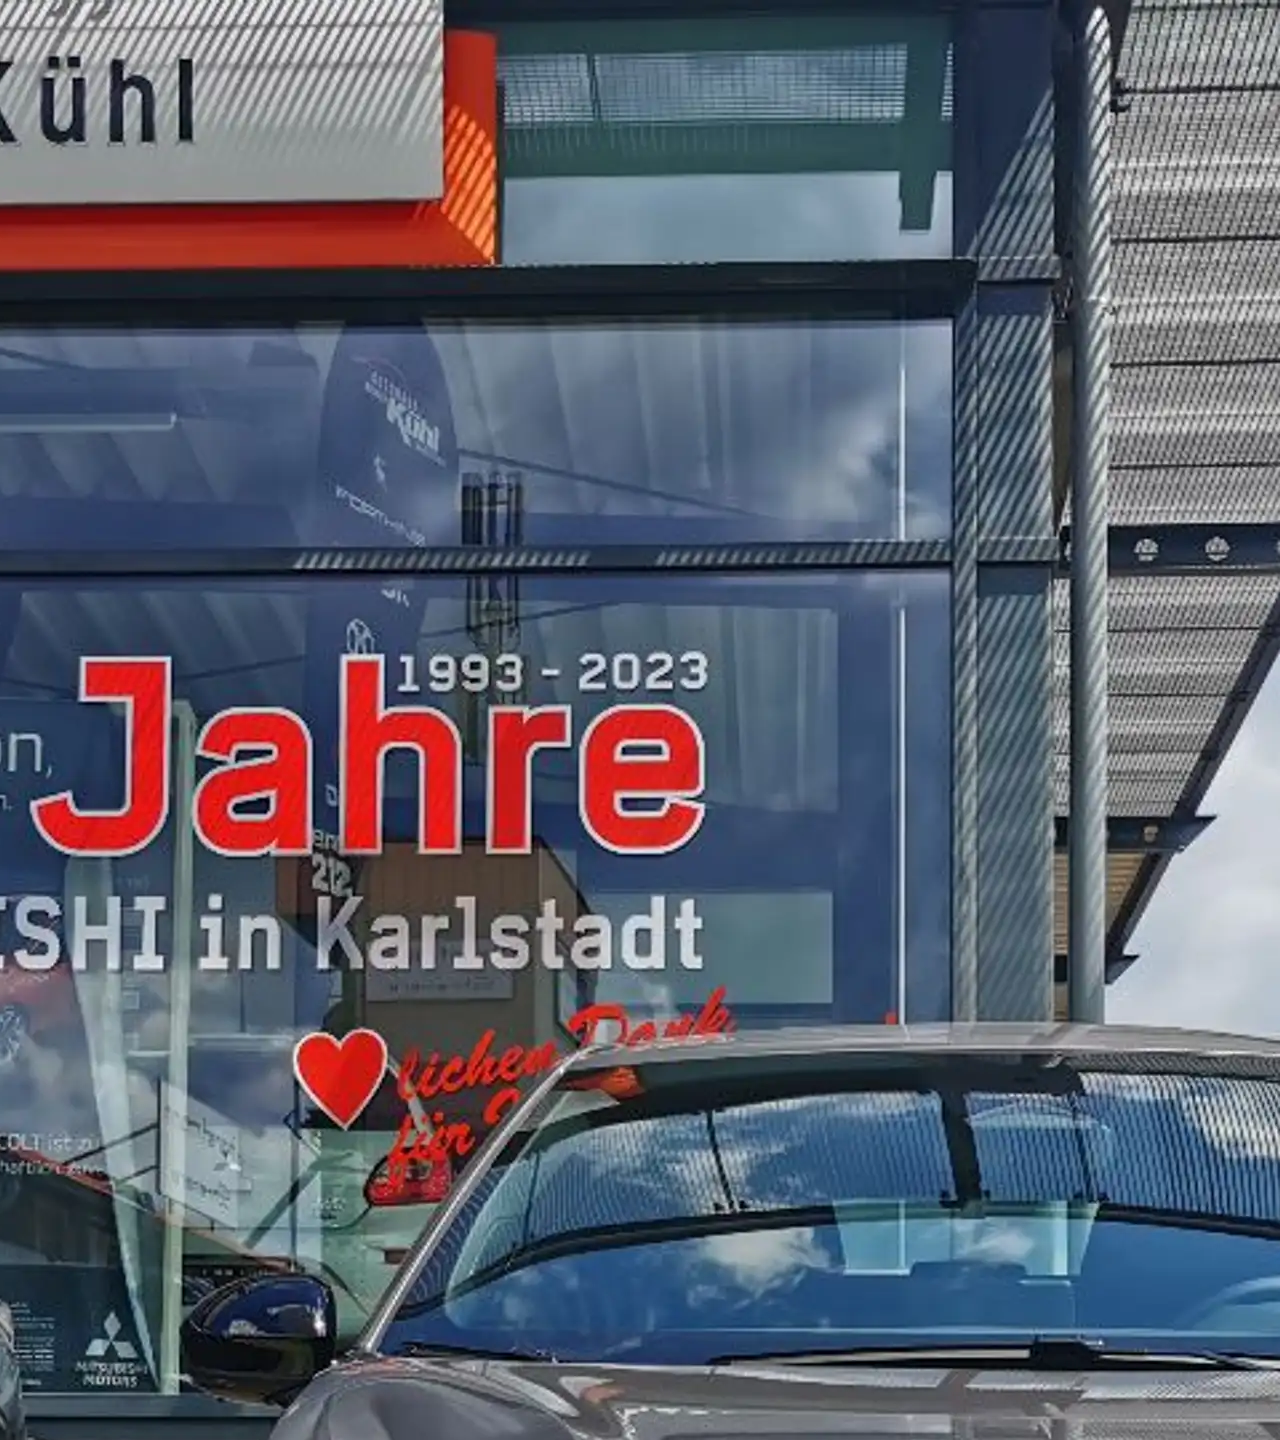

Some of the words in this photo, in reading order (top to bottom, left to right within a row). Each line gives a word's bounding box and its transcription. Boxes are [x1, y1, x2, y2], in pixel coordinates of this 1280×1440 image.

[398, 653, 524, 694] 1993
[578, 651, 709, 693] 2023
[30, 652, 708, 858] Jahre
[200, 894, 282, 971] in
[317, 895, 704, 971] Karlstadt
[397, 1028, 558, 1100] lichen
